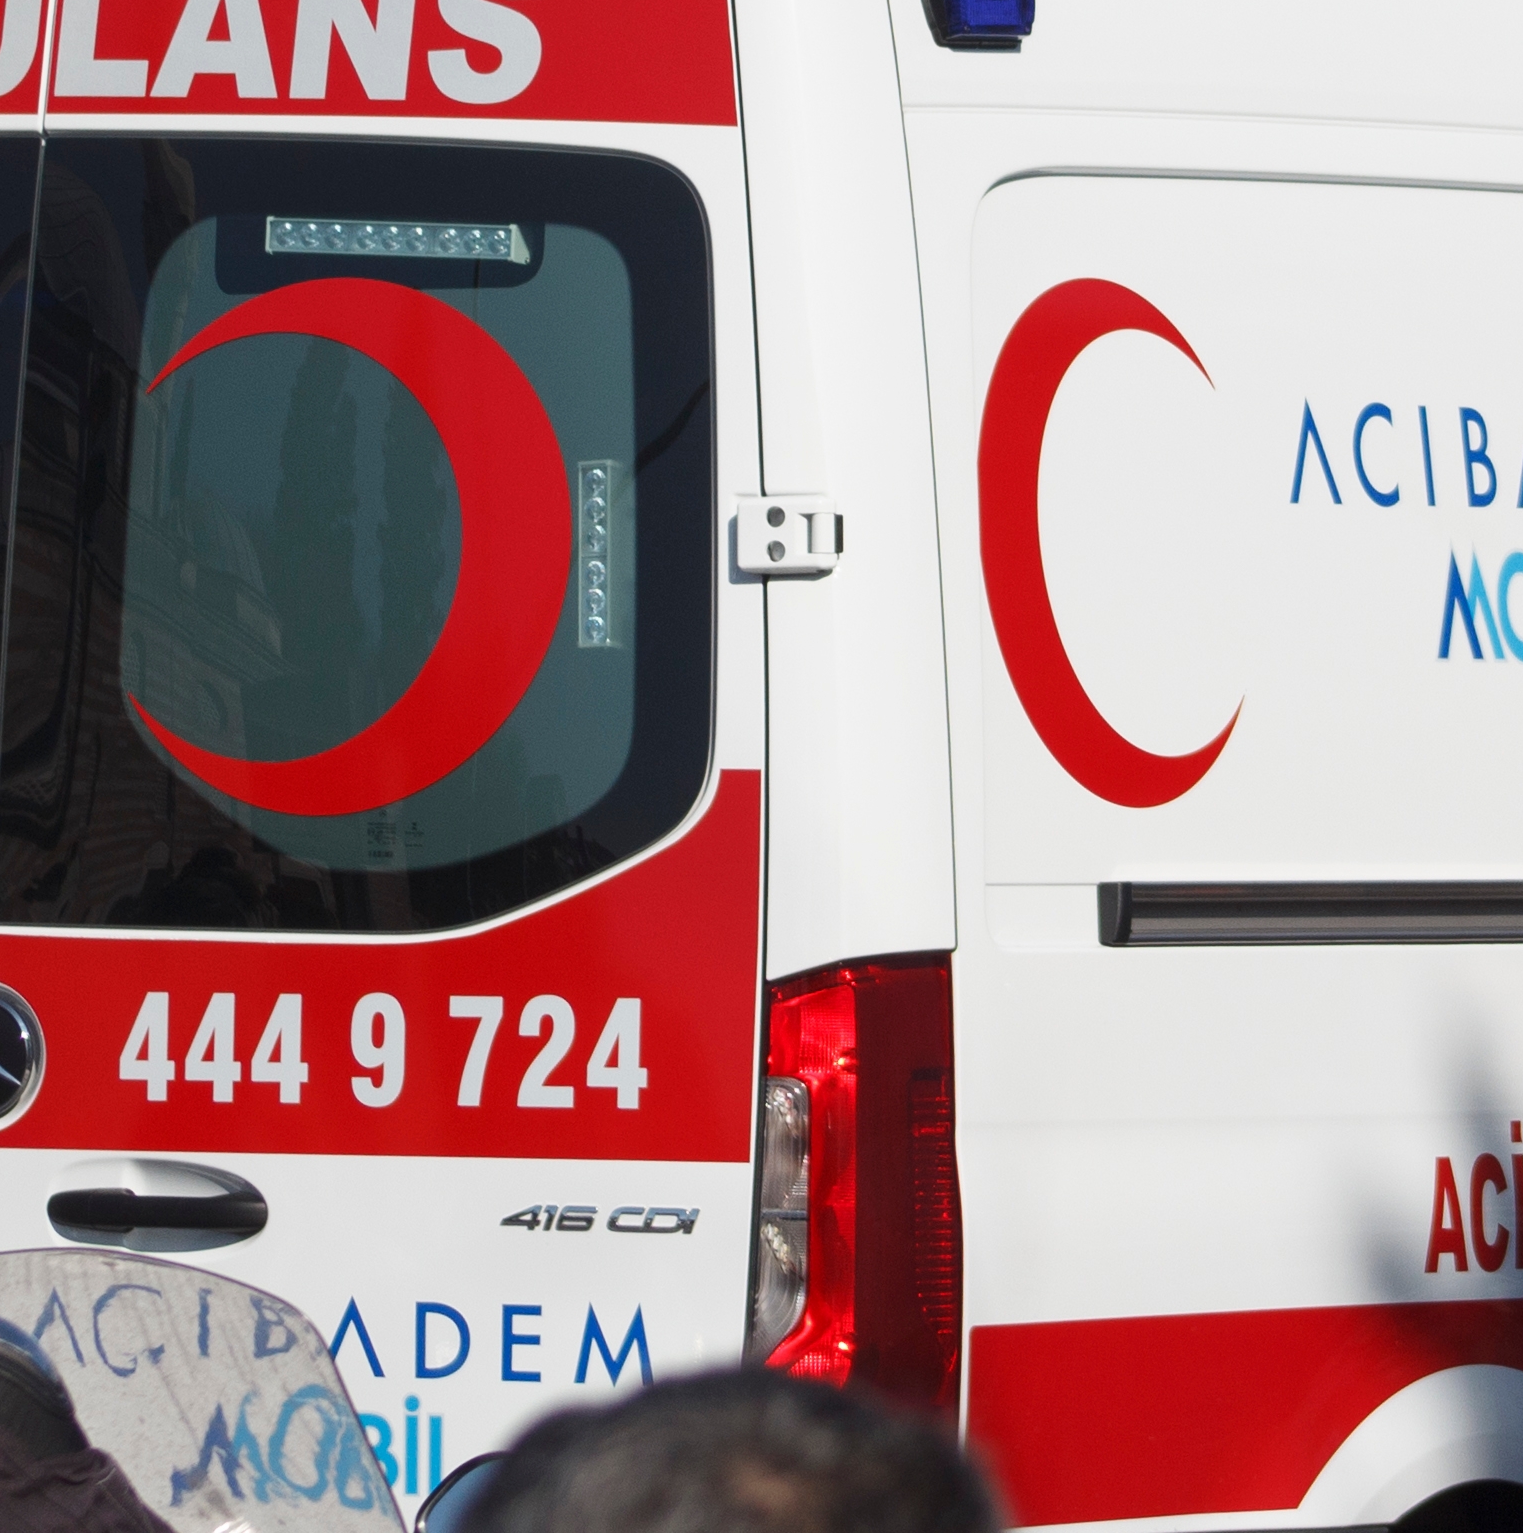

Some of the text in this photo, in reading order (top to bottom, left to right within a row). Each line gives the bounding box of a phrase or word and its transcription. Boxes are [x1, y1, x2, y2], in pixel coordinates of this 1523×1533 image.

[119, 991, 309, 1104] 444
[351, 992, 406, 1107] 9
[448, 994, 648, 1110] 724
[501, 1204, 701, 1236] 416 CDI
